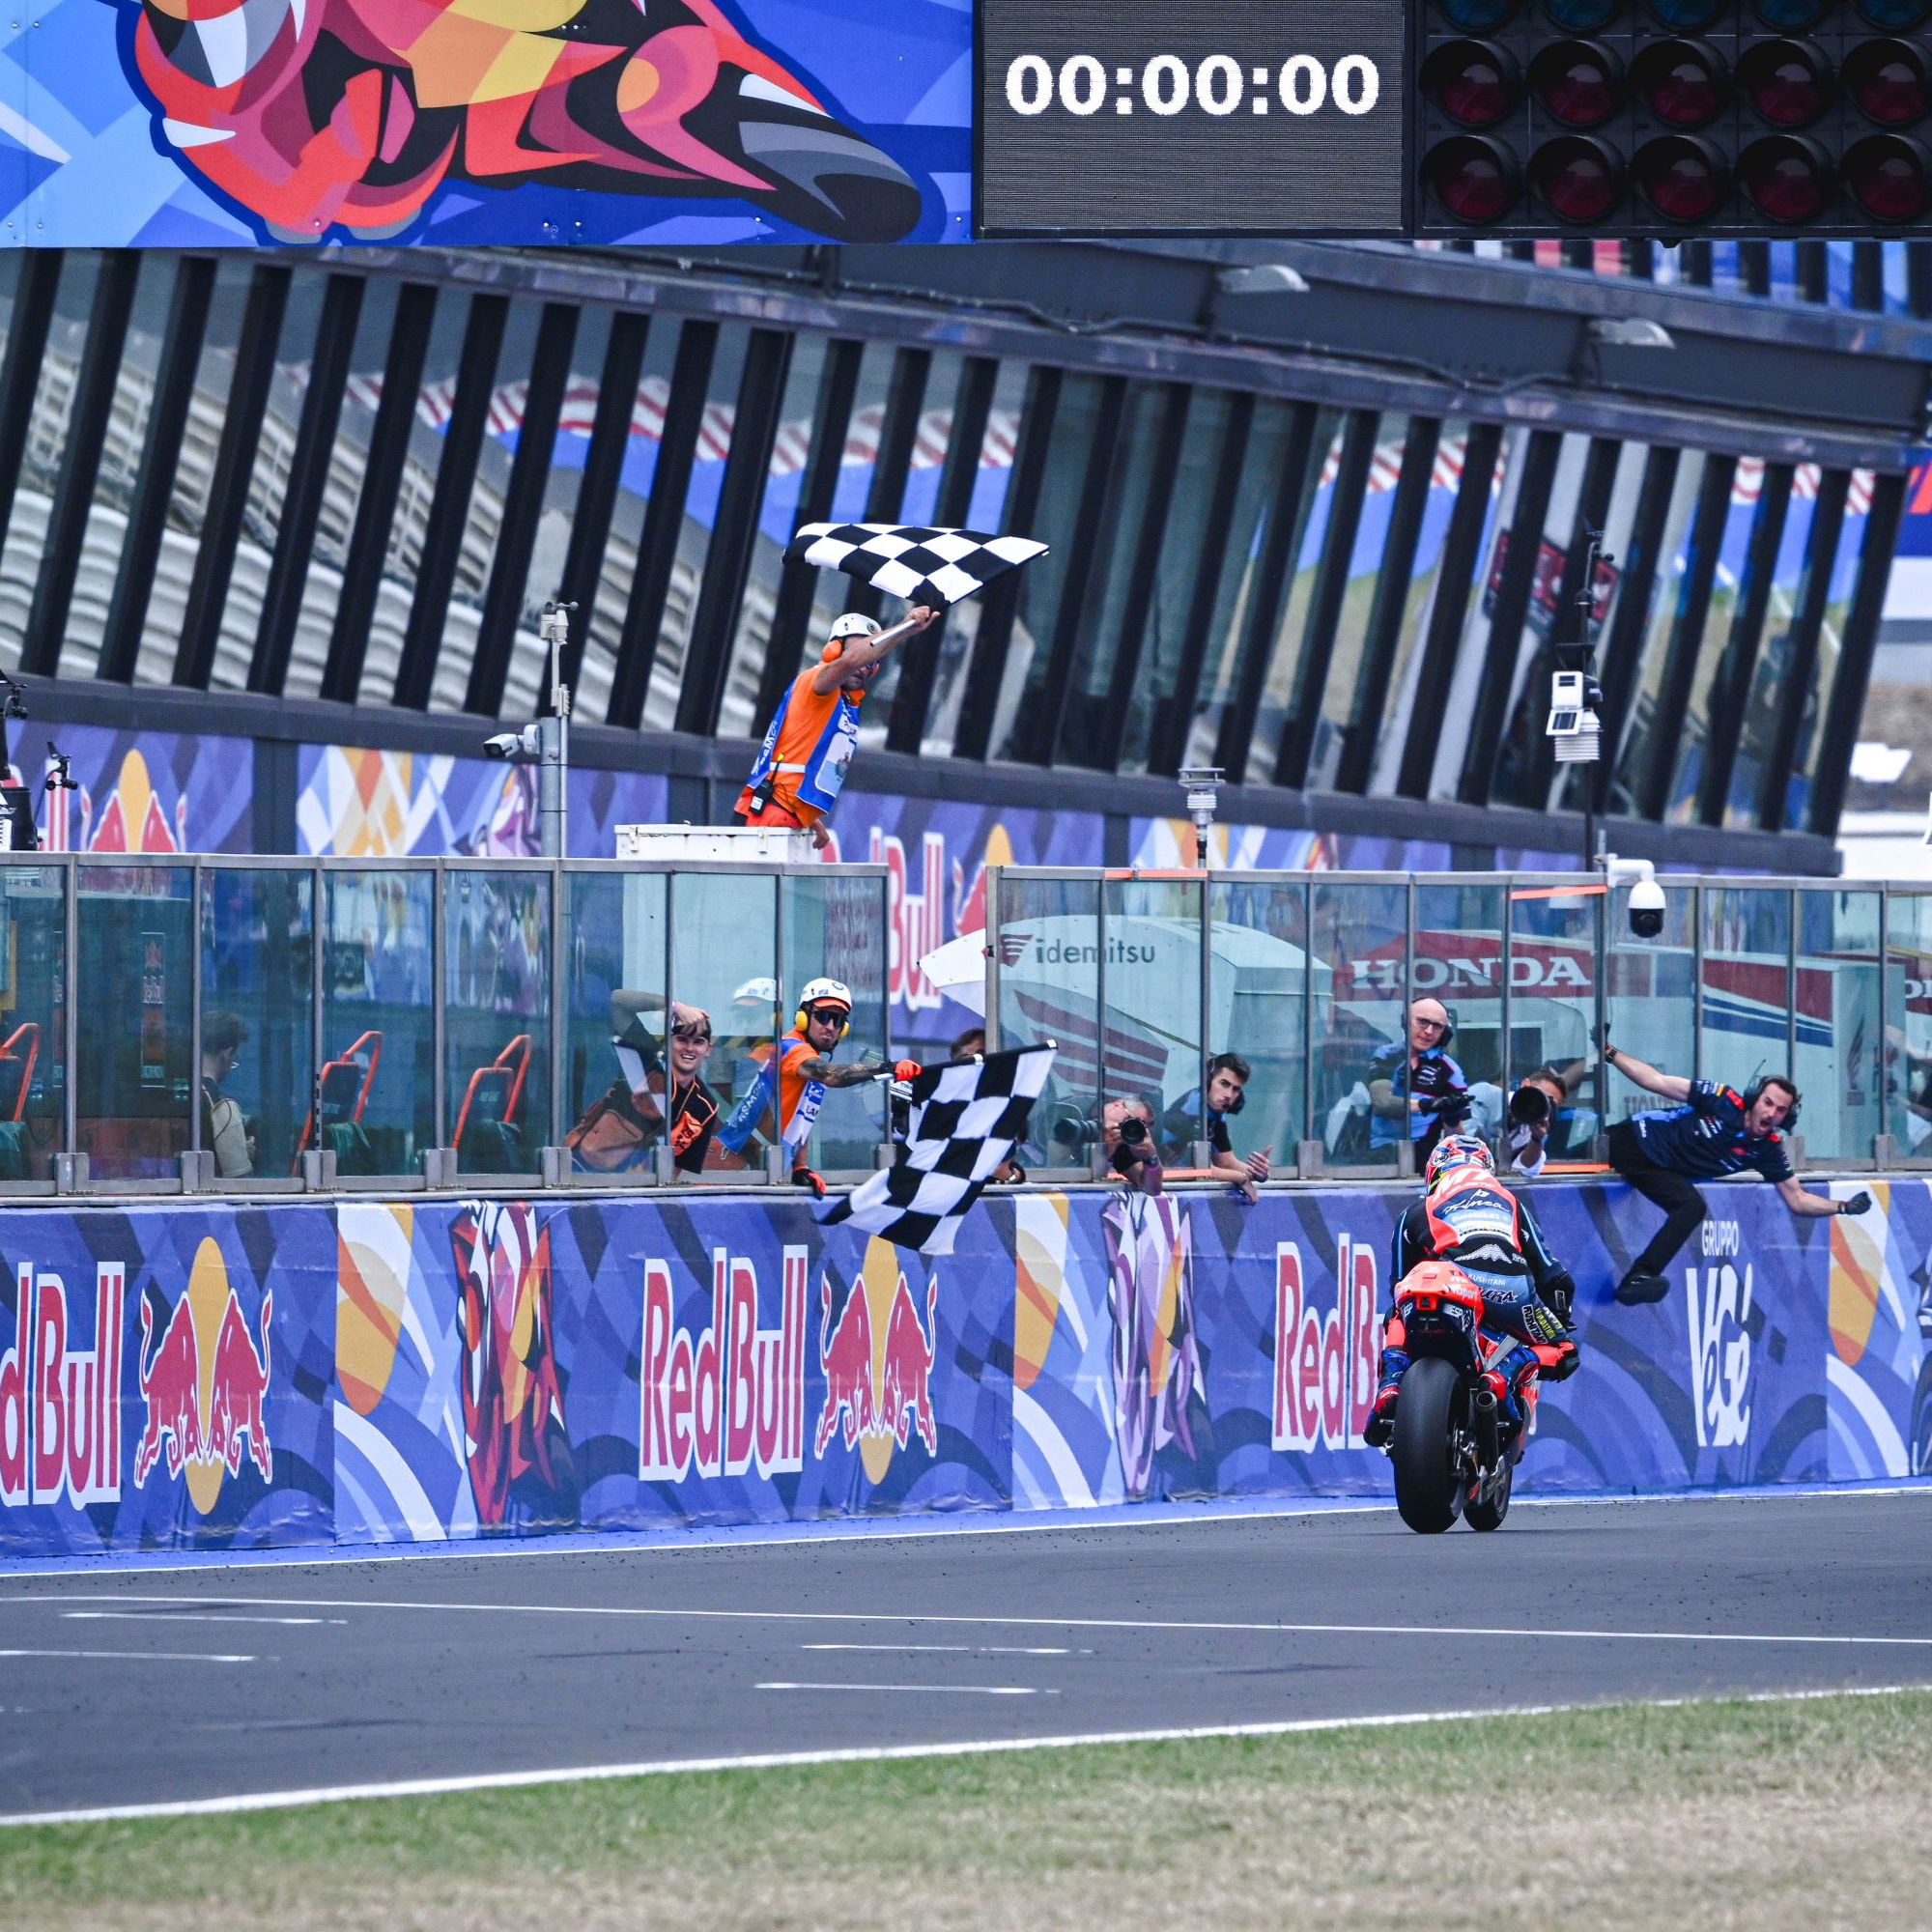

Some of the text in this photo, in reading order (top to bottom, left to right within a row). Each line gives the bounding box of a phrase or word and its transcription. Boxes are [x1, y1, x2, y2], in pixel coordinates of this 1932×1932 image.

[1006, 54, 1379, 116] 00:00:00
[1036, 938, 1155, 964] idemitsu
[1351, 955, 1592, 989] HONDA
[1702, 1220, 1739, 1257] GRUPPO
[1468, 1273, 1506, 1286] KUSHITANI
